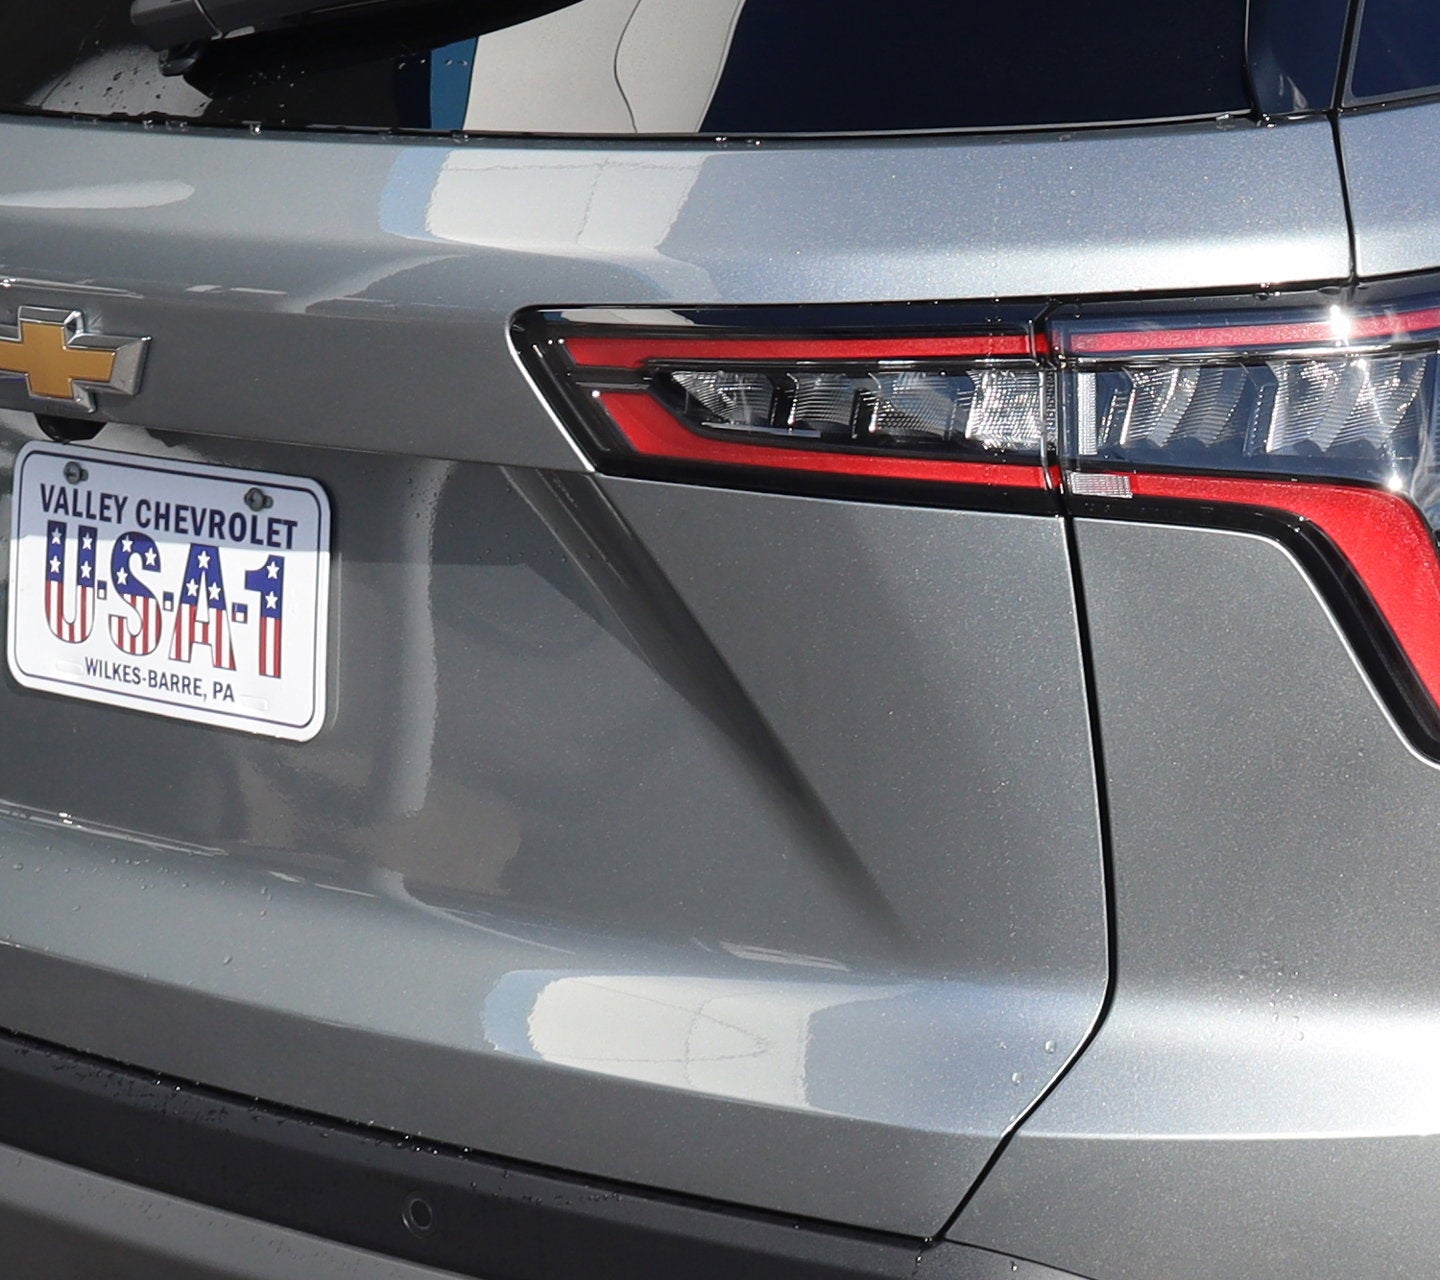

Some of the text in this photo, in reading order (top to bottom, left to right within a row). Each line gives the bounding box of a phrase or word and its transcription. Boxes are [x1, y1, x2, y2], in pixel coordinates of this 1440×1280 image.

[40, 483, 299, 550] VALLEY CHEVROLET
[84, 656, 235, 703] WILKES-BARRE, PA
